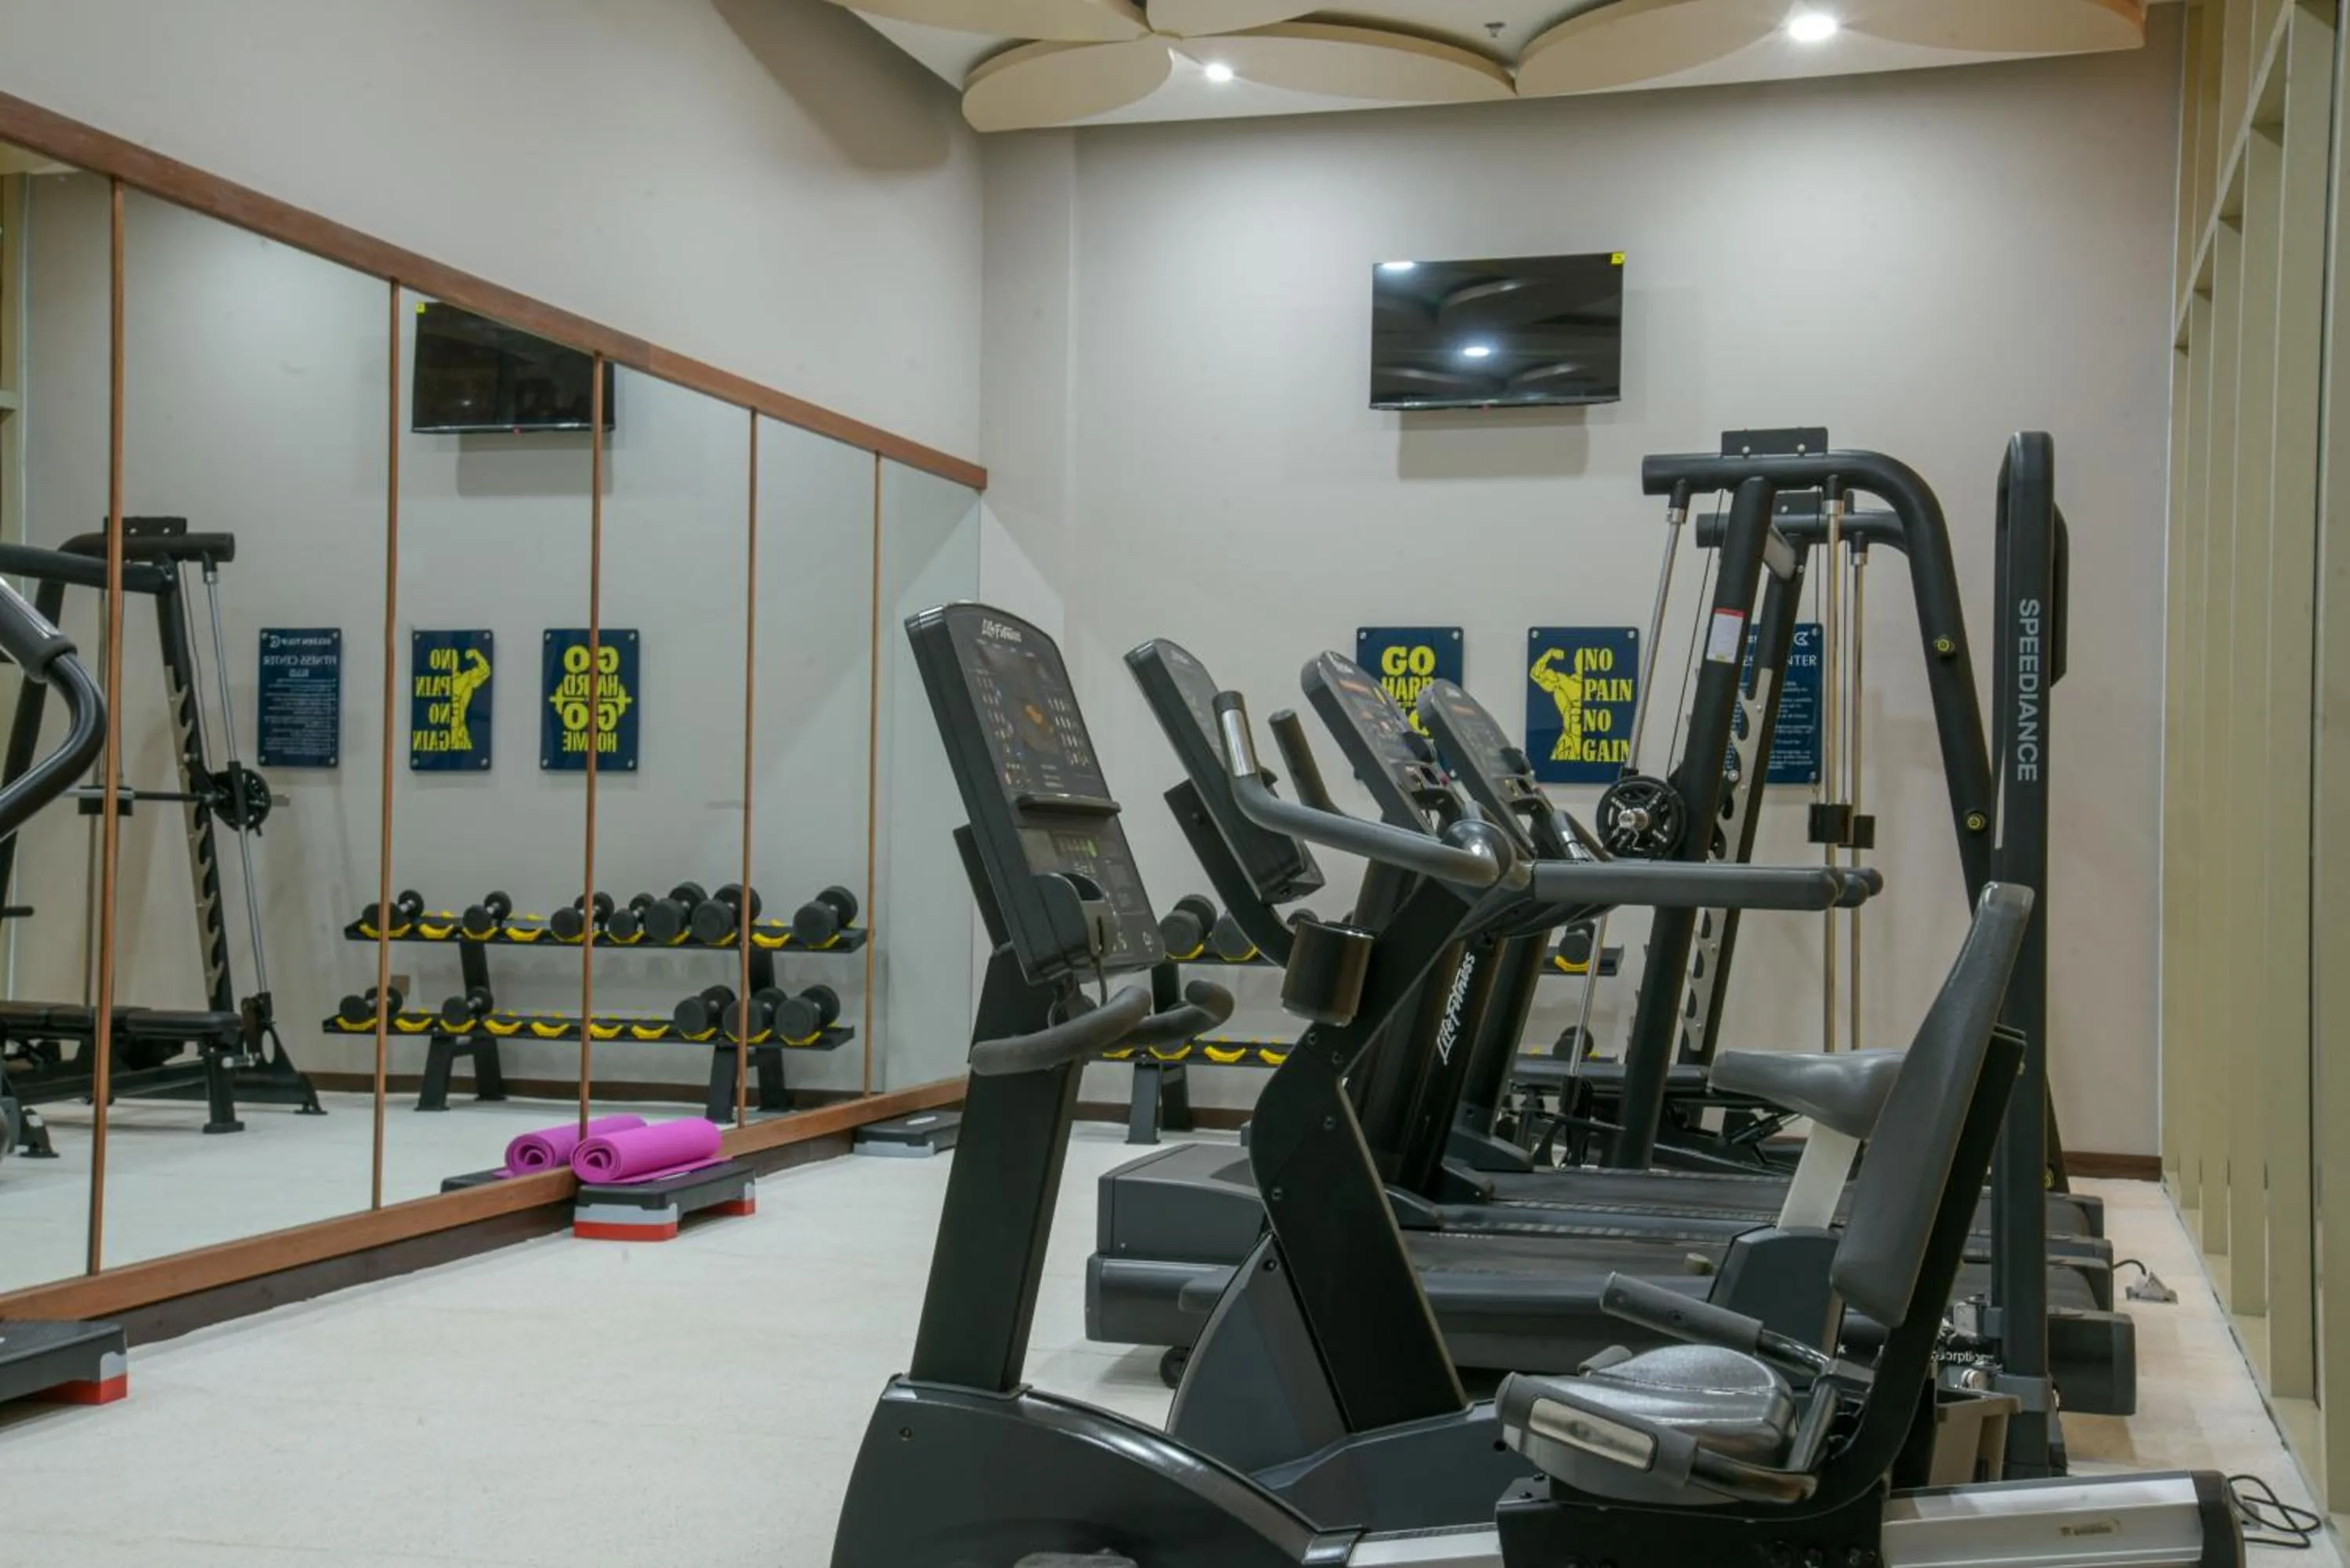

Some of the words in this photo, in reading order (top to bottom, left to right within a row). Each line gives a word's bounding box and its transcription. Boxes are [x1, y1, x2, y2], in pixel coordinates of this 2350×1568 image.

[1382, 646, 1435, 675] GO
[1585, 649, 1613, 671] NO
[1584, 679, 1632, 701] PAIN
[2018, 599, 2040, 781] SPEEDIANCE
[1583, 710, 1612, 732] NO
[1582, 739, 1629, 762] GAIN
